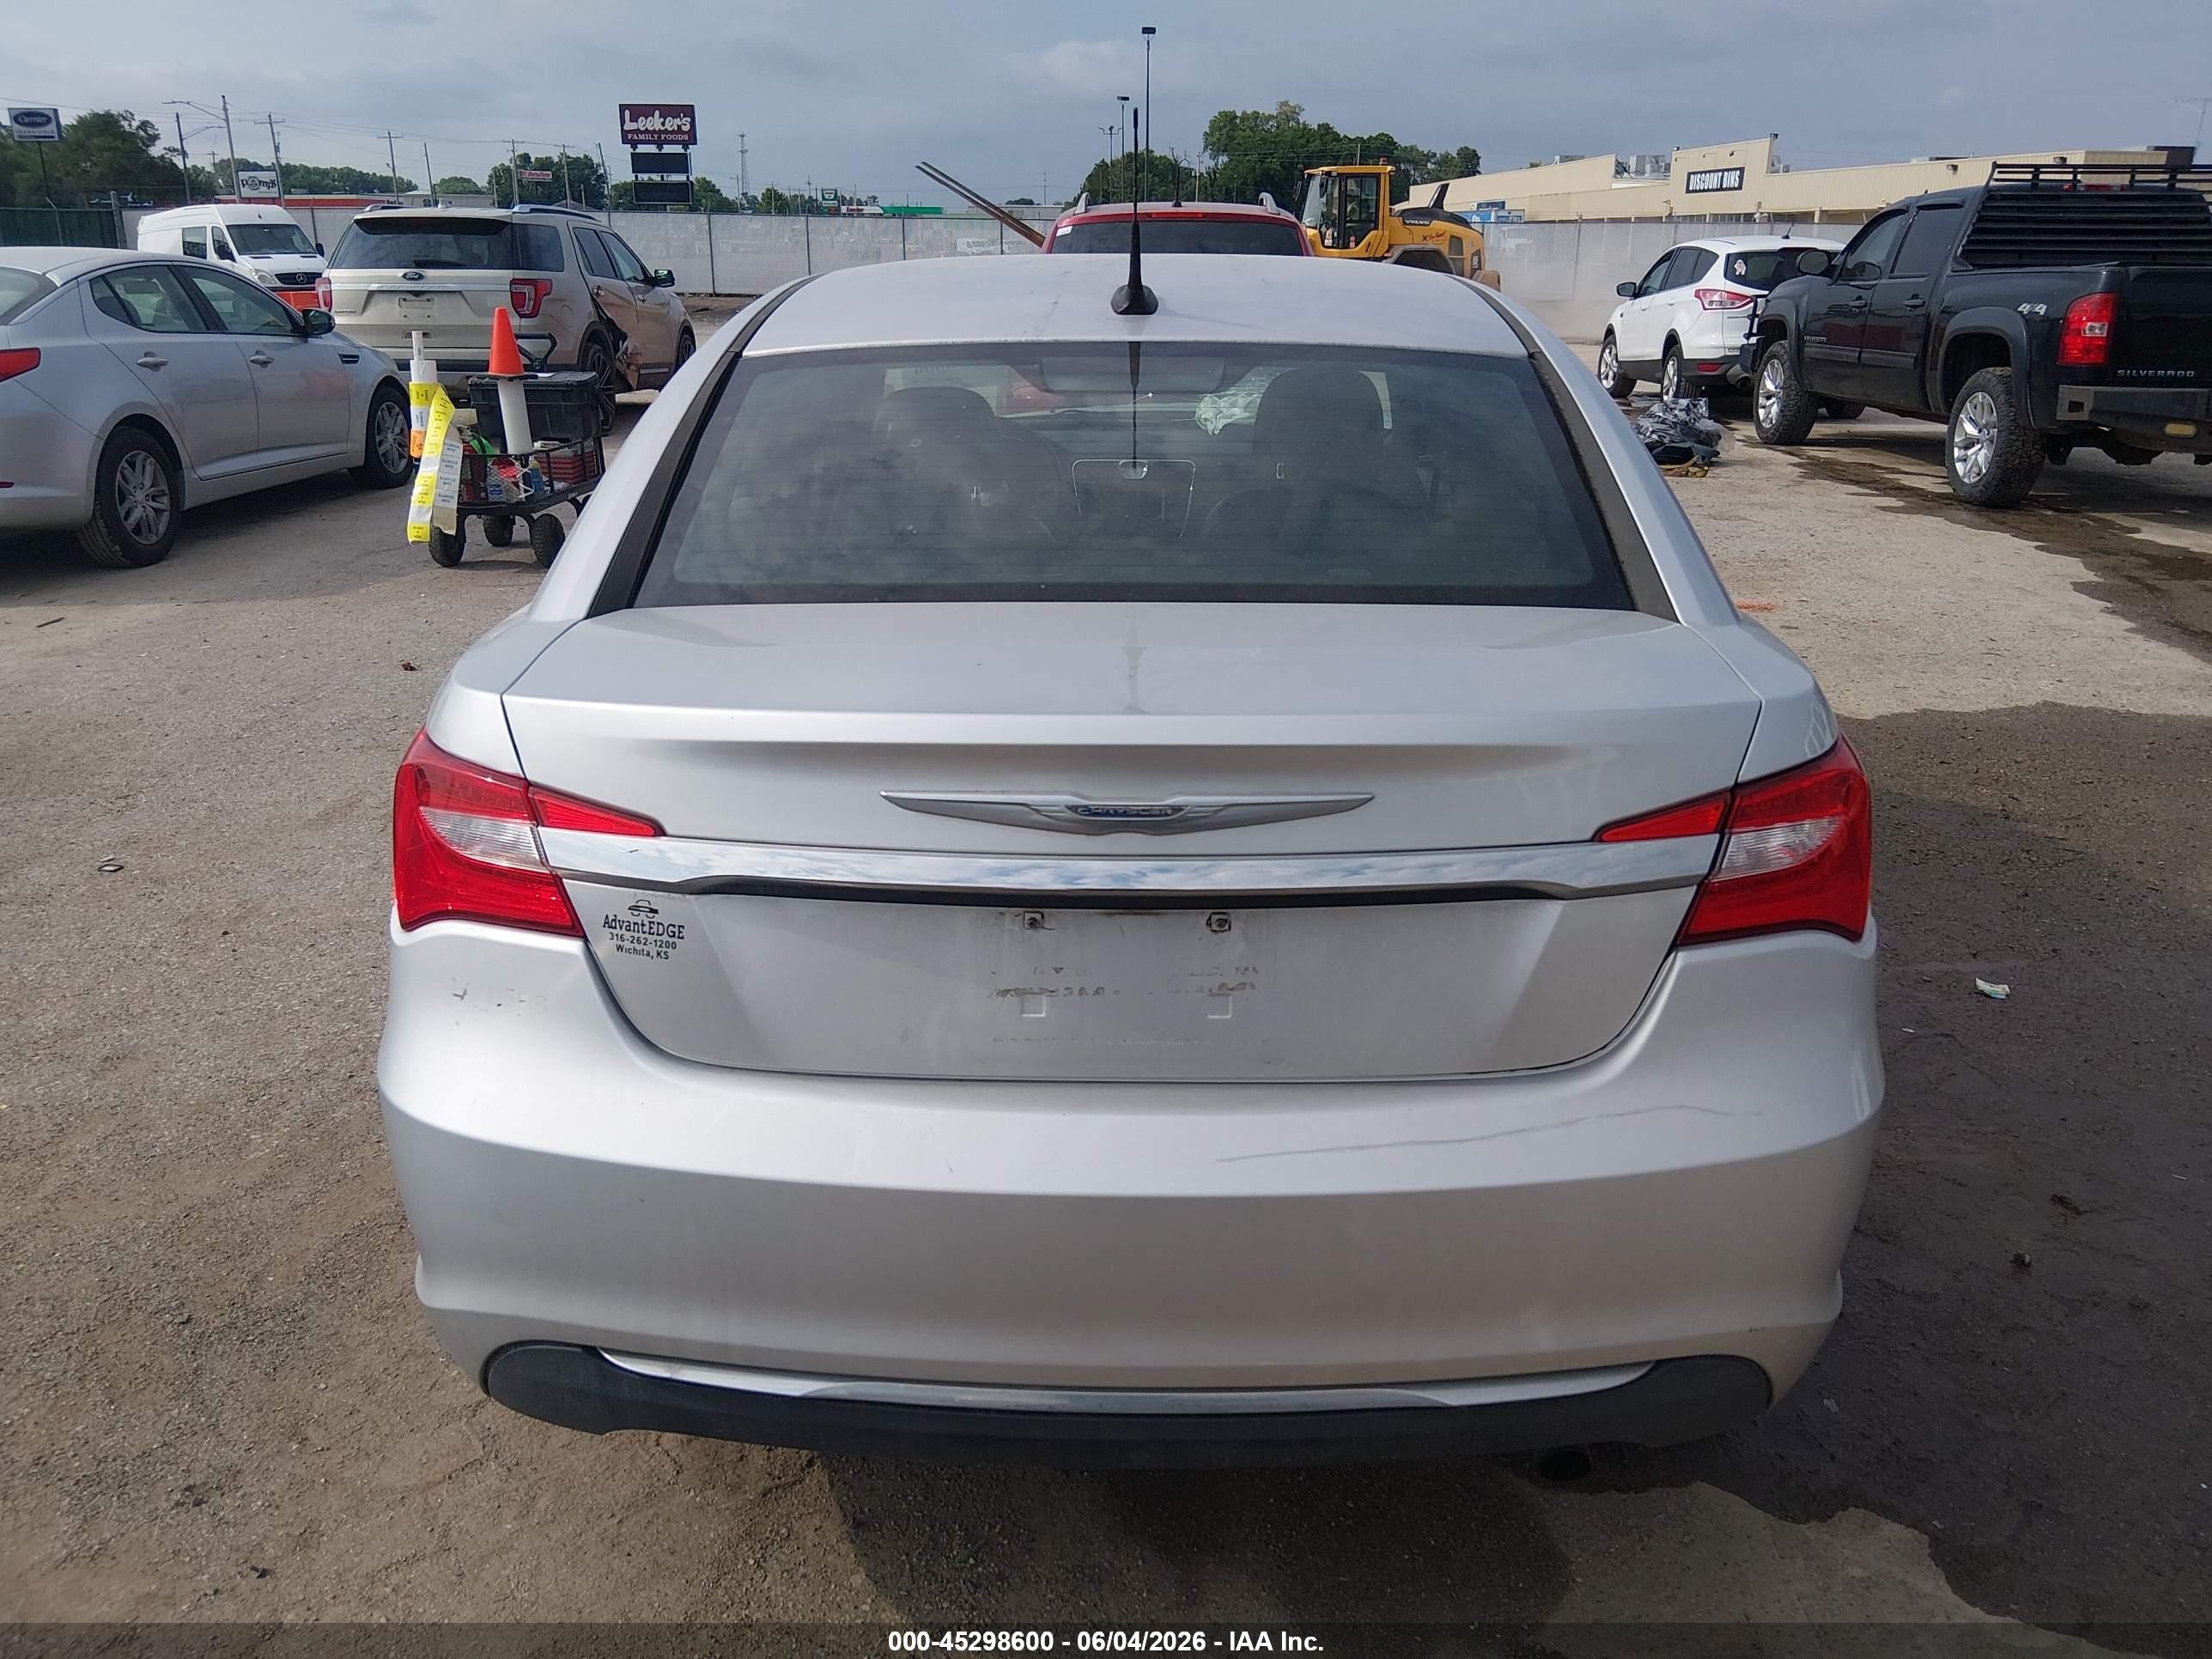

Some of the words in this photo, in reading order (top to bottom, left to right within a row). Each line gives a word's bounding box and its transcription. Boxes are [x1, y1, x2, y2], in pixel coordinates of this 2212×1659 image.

[623, 109, 690, 131] Leeker's
[1689, 171, 1722, 191] DISCOUNT
[1723, 169, 1741, 189] BINS
[2116, 369, 2195, 378] SILVERADO
[603, 914, 684, 939] AdvantEDGE
[609, 932, 677, 950] 316-262-1200
[616, 944, 654, 960] Wichita,
[656, 950, 670, 960] KS
